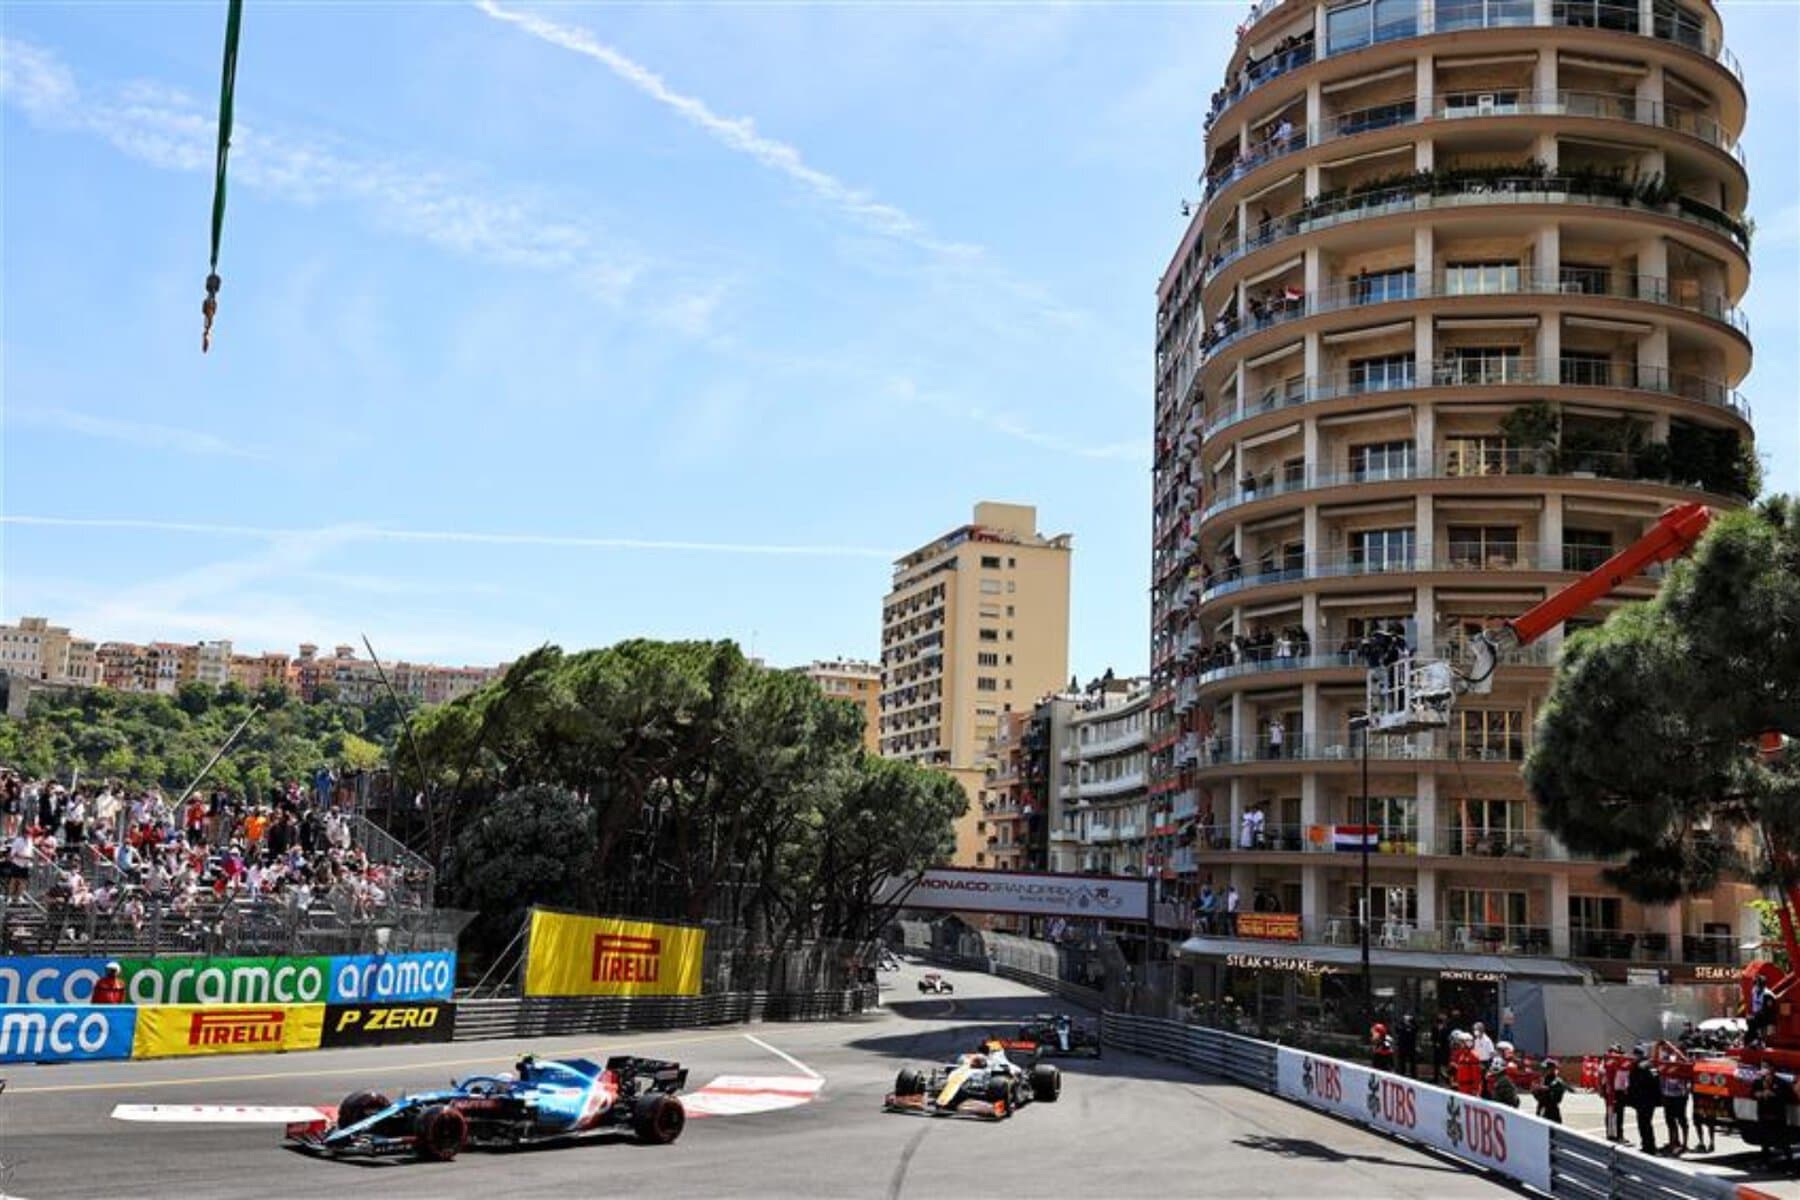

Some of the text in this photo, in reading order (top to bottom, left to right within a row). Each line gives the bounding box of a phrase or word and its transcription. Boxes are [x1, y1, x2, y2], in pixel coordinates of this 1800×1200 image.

[592, 933, 660, 982] PIRELLI
[1226, 954, 1262, 968] STEAK
[1272, 958, 1315, 972] SHAKE
[129, 966, 322, 1004] aramco
[337, 959, 449, 998] aramco
[189, 1011, 285, 1046] PIRELLI
[335, 1007, 439, 1032] P ZERO
[1314, 1060, 1342, 1102] UBS
[1382, 1079, 1416, 1129] UBS
[1464, 1104, 1508, 1163] UBS
